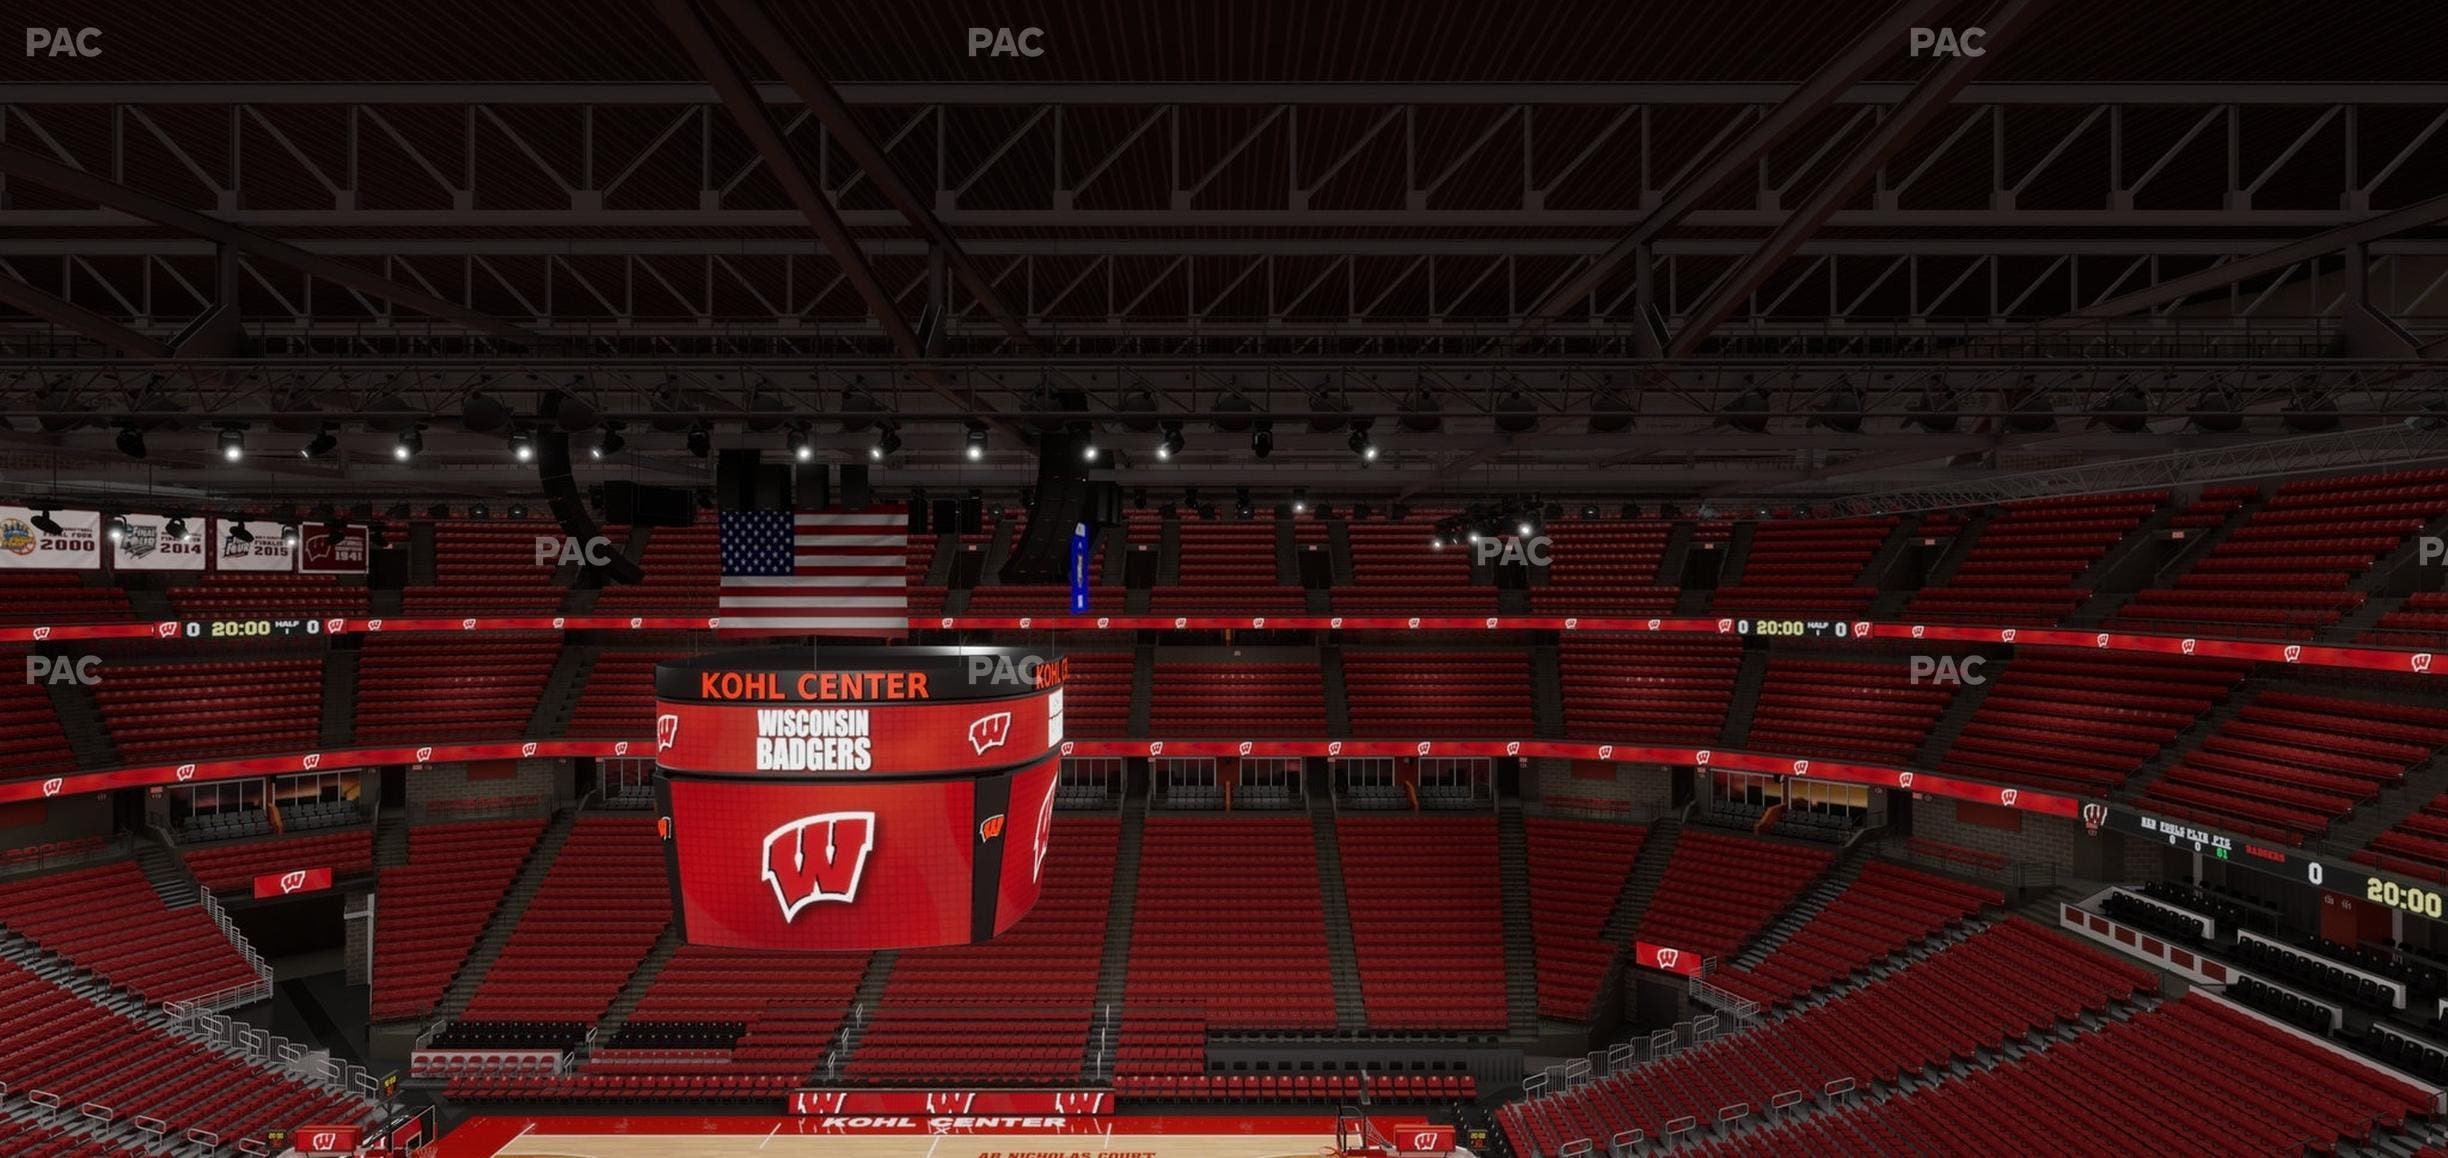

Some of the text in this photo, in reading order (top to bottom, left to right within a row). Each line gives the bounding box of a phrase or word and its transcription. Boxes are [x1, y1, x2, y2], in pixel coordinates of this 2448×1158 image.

[40, 539, 95, 551] 2000
[160, 543, 202, 553] 2014
[254, 546, 288, 556] 2015
[335, 551, 362, 561] 1941
[186, 620, 320, 637] 0 20:00 HALF 0
[1738, 619, 1749, 634] 0
[1756, 620, 1804, 636] 20:00
[1835, 622, 1847, 637] 0
[2412, 654, 2431, 672] W
[1036, 658, 1061, 689] KOHL
[702, 672, 930, 699] KOHL CENTER
[757, 709, 869, 737] WISCONSIN
[968, 711, 1011, 756] W
[756, 737, 872, 771] BADGERS
[177, 764, 195, 781] W
[43, 778, 62, 796] W
[2083, 803, 2108, 827] W
[761, 810, 876, 924] W
[2308, 862, 2323, 885] 0
[281, 871, 306, 893] W
[2367, 877, 2443, 918] 20:00
[1657, 948, 1678, 968] W
[822, 1117, 1067, 1128] KOHL CENTER
